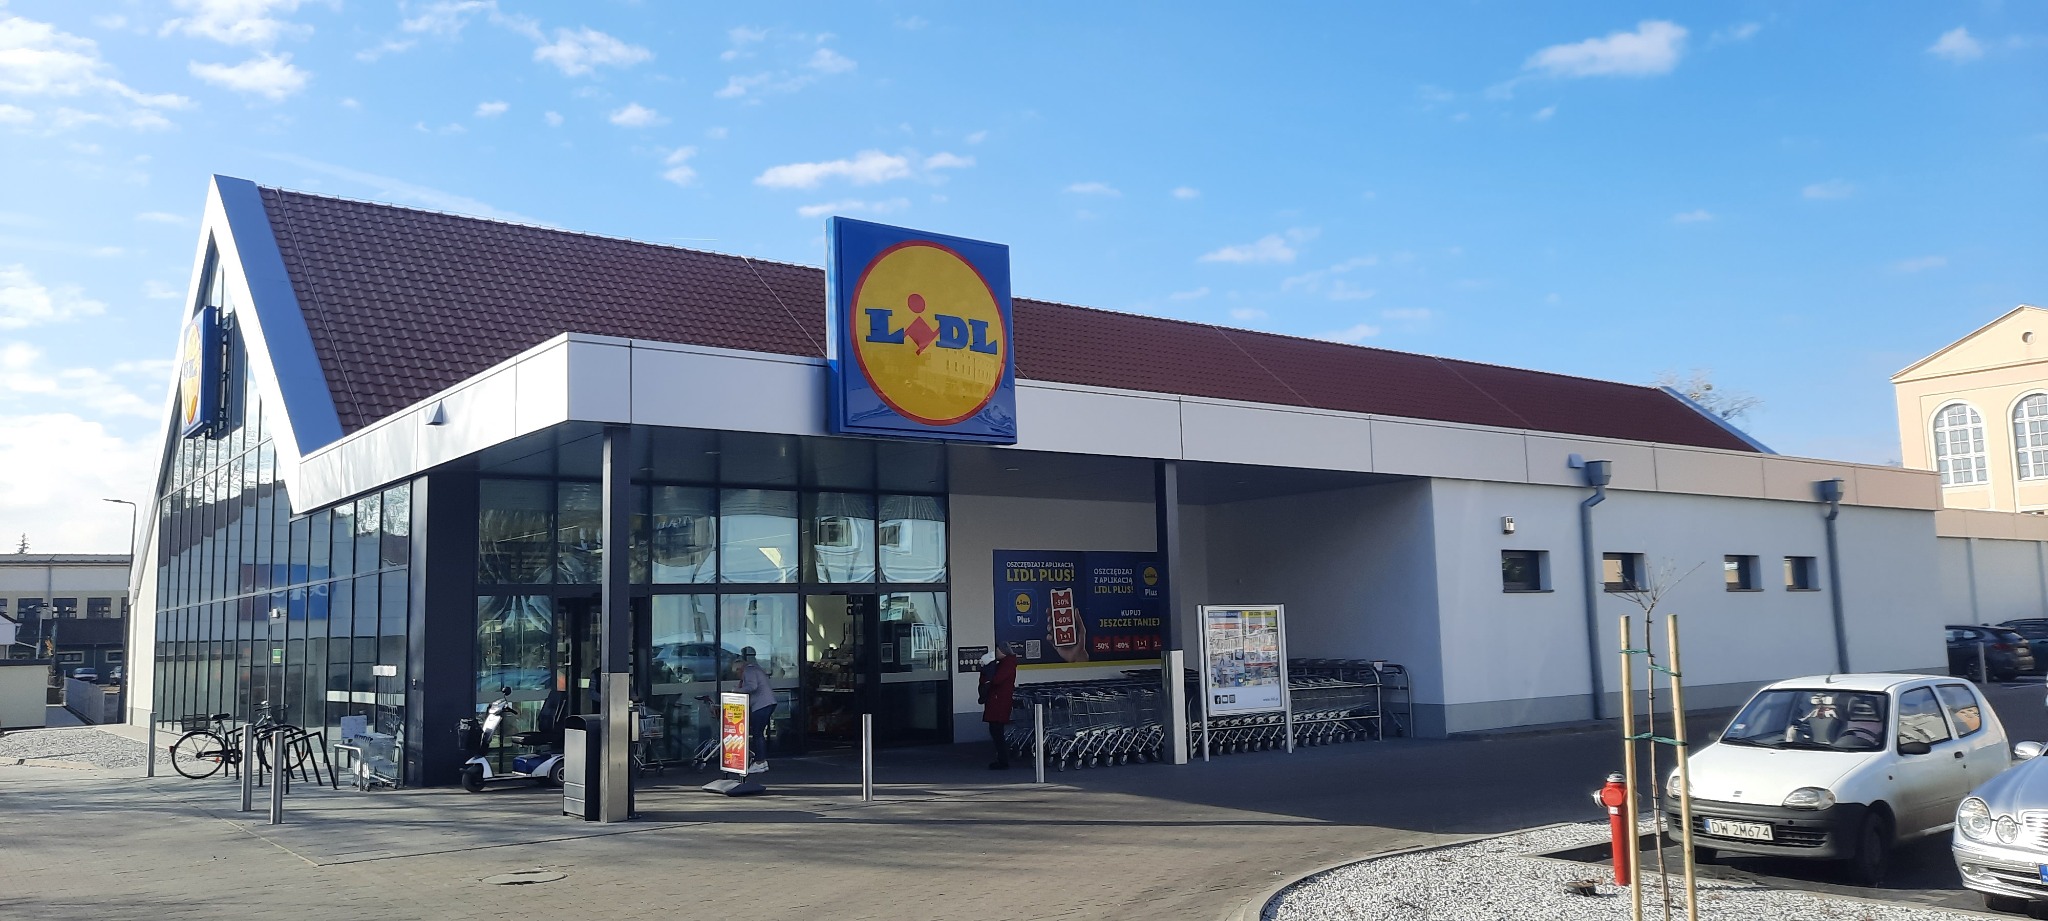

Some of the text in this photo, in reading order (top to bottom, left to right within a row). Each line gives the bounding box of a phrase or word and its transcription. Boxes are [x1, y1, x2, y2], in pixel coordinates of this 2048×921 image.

[1006, 568, 1075, 582] LIDL PLUS!
[1094, 586, 1134, 594] LIDL PLUS!
[1144, 588, 1158, 596] Plus
[1016, 615, 1031, 624] Plus
[1056, 616, 1071, 624] -60%
[1099, 617, 1160, 628] JESZCZE TANIEJ
[1059, 632, 1071, 640] 1+1
[1711, 821, 1769, 838] DW 2M674
